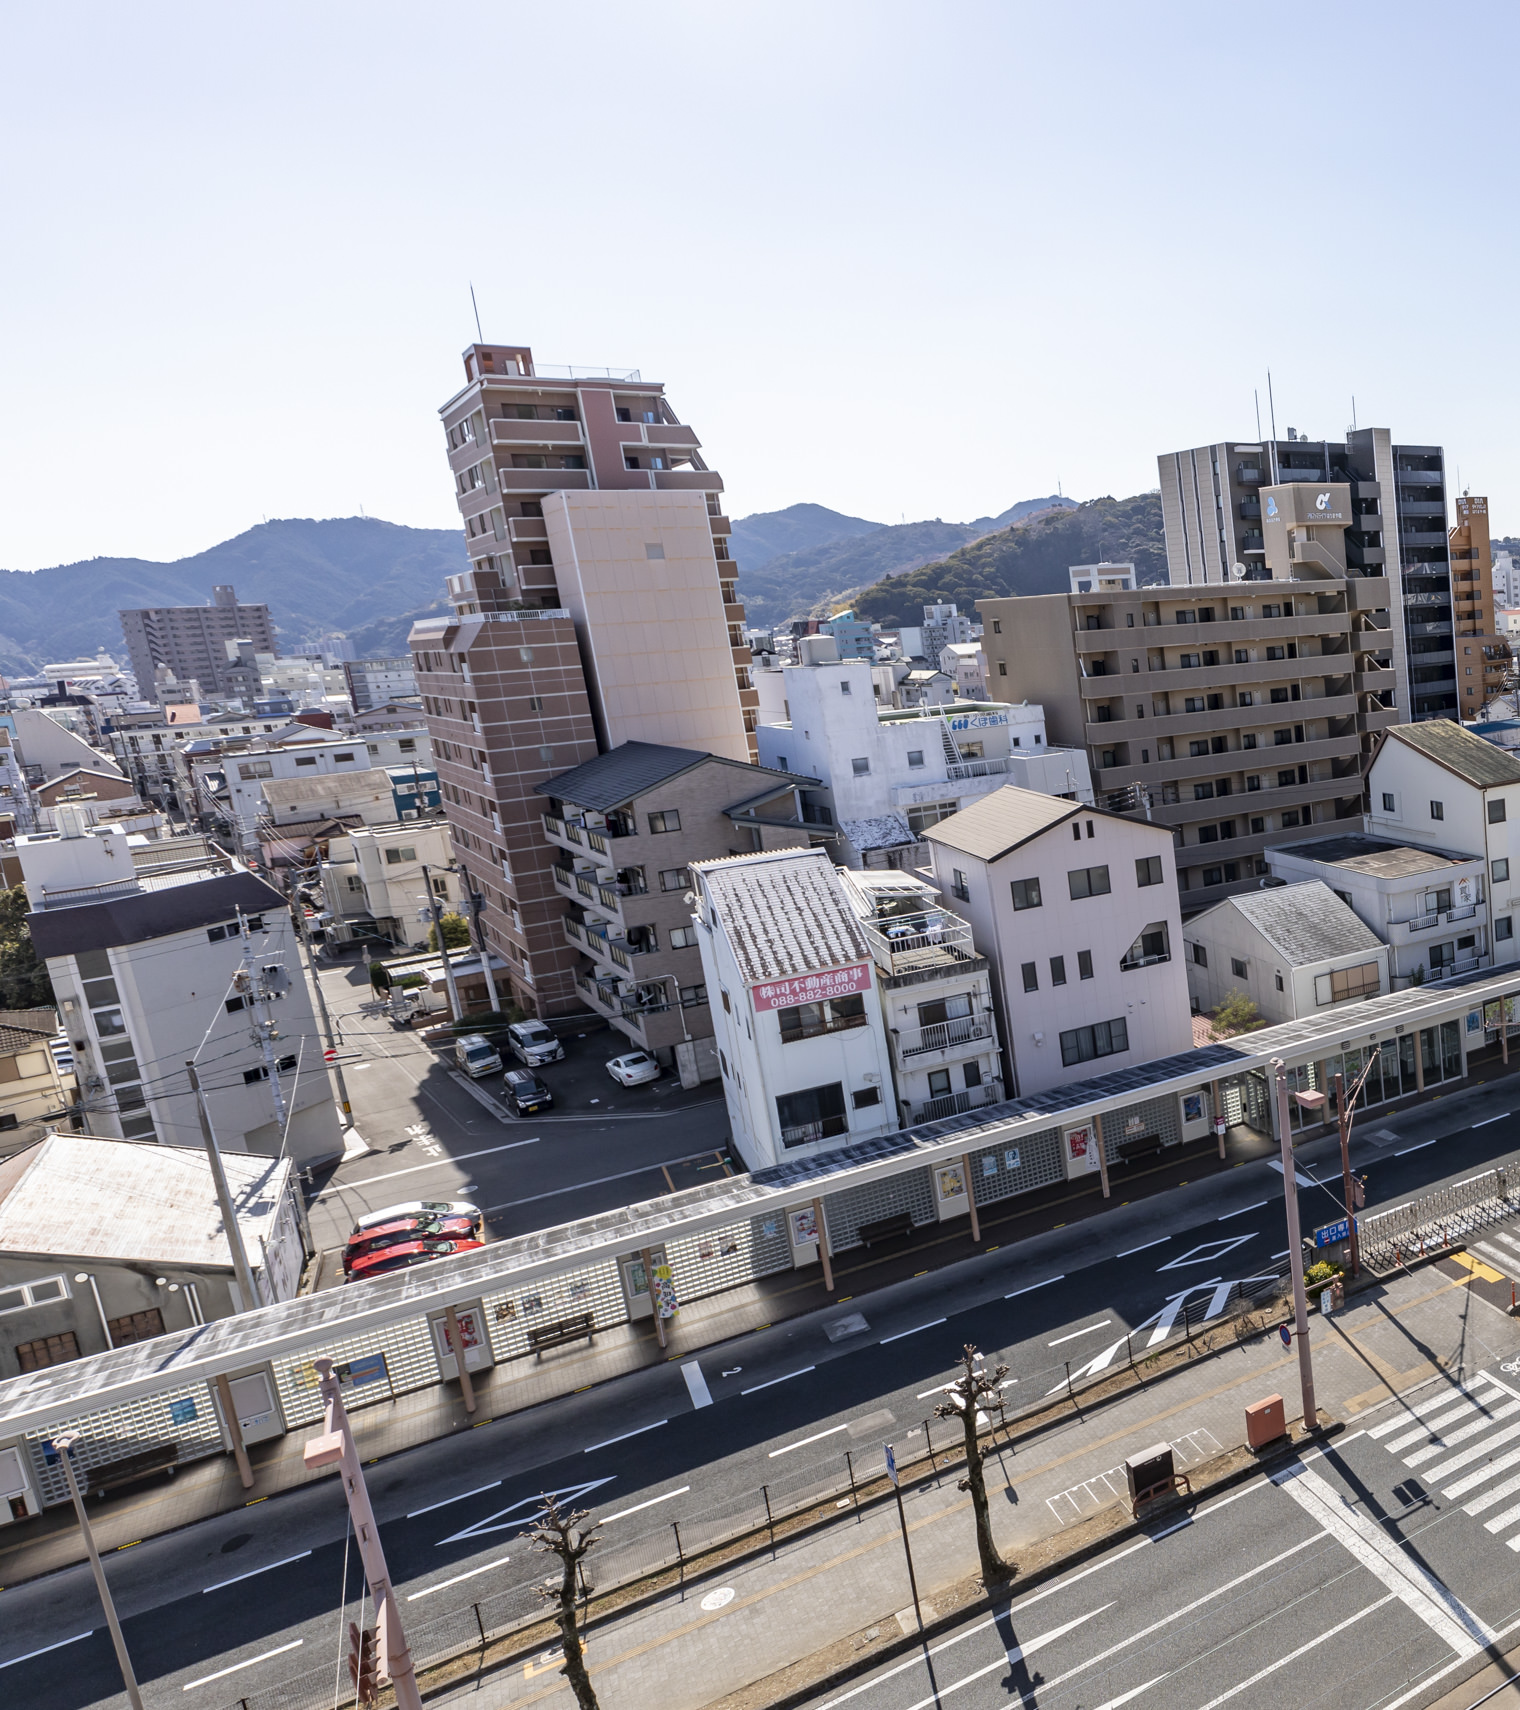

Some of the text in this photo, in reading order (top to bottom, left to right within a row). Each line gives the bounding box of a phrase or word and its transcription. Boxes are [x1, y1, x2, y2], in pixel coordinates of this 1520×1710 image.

[970, 714, 1008, 728] くぼ歯科
[770, 982, 856, 1007] 088-882-8000
